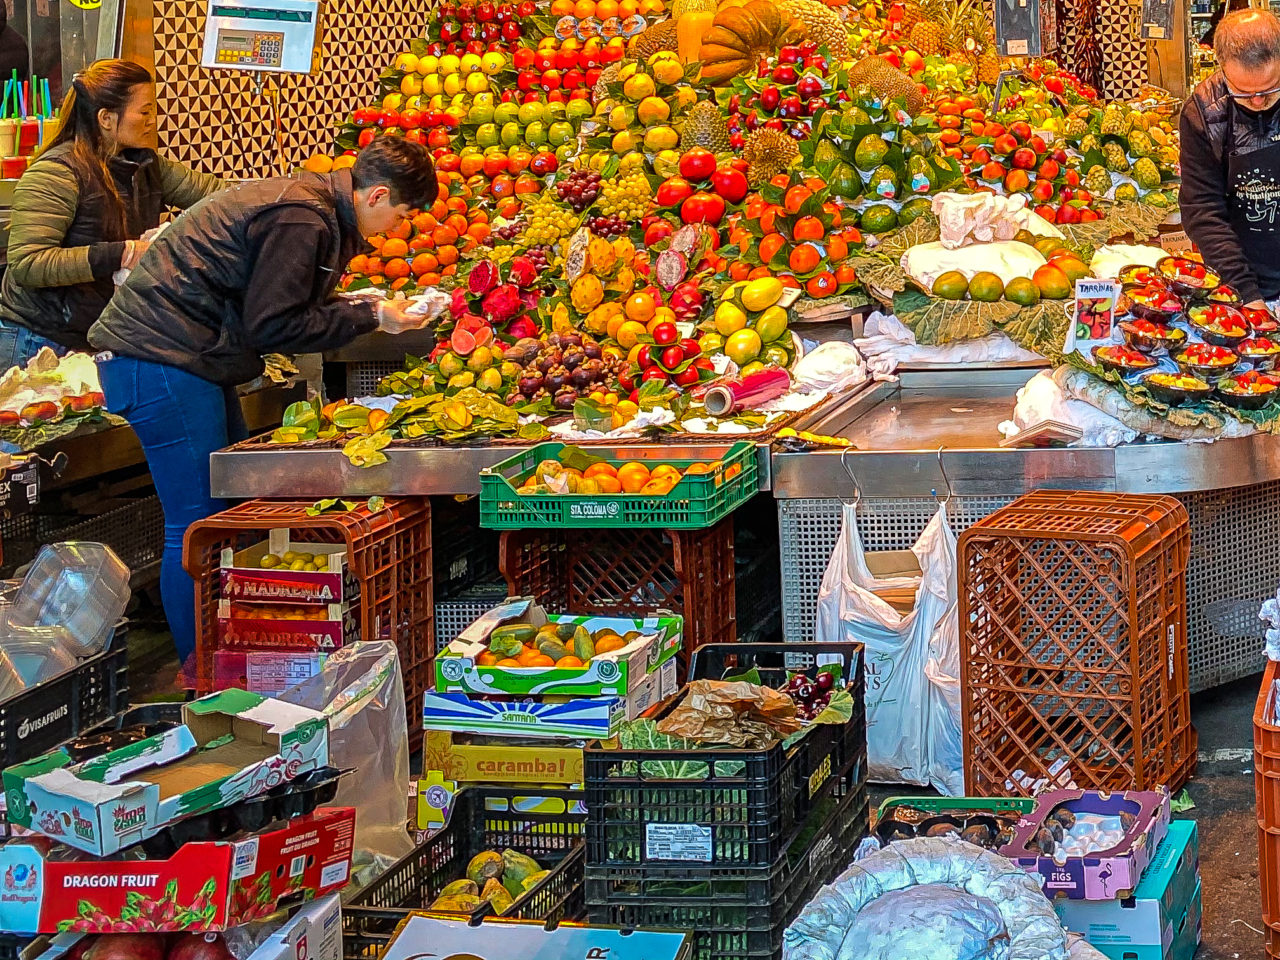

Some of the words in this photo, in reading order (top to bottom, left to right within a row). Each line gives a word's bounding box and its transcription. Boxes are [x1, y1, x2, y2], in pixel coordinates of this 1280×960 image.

[30, 704, 68, 732] VISAFRUITS
[501, 713, 537, 724] SANTANA
[476, 758, 566, 778] caramba!
[63, 875, 118, 888] DRAGON
[121, 874, 159, 887] FRUIT
[1051, 872, 1072, 882] FIGS
